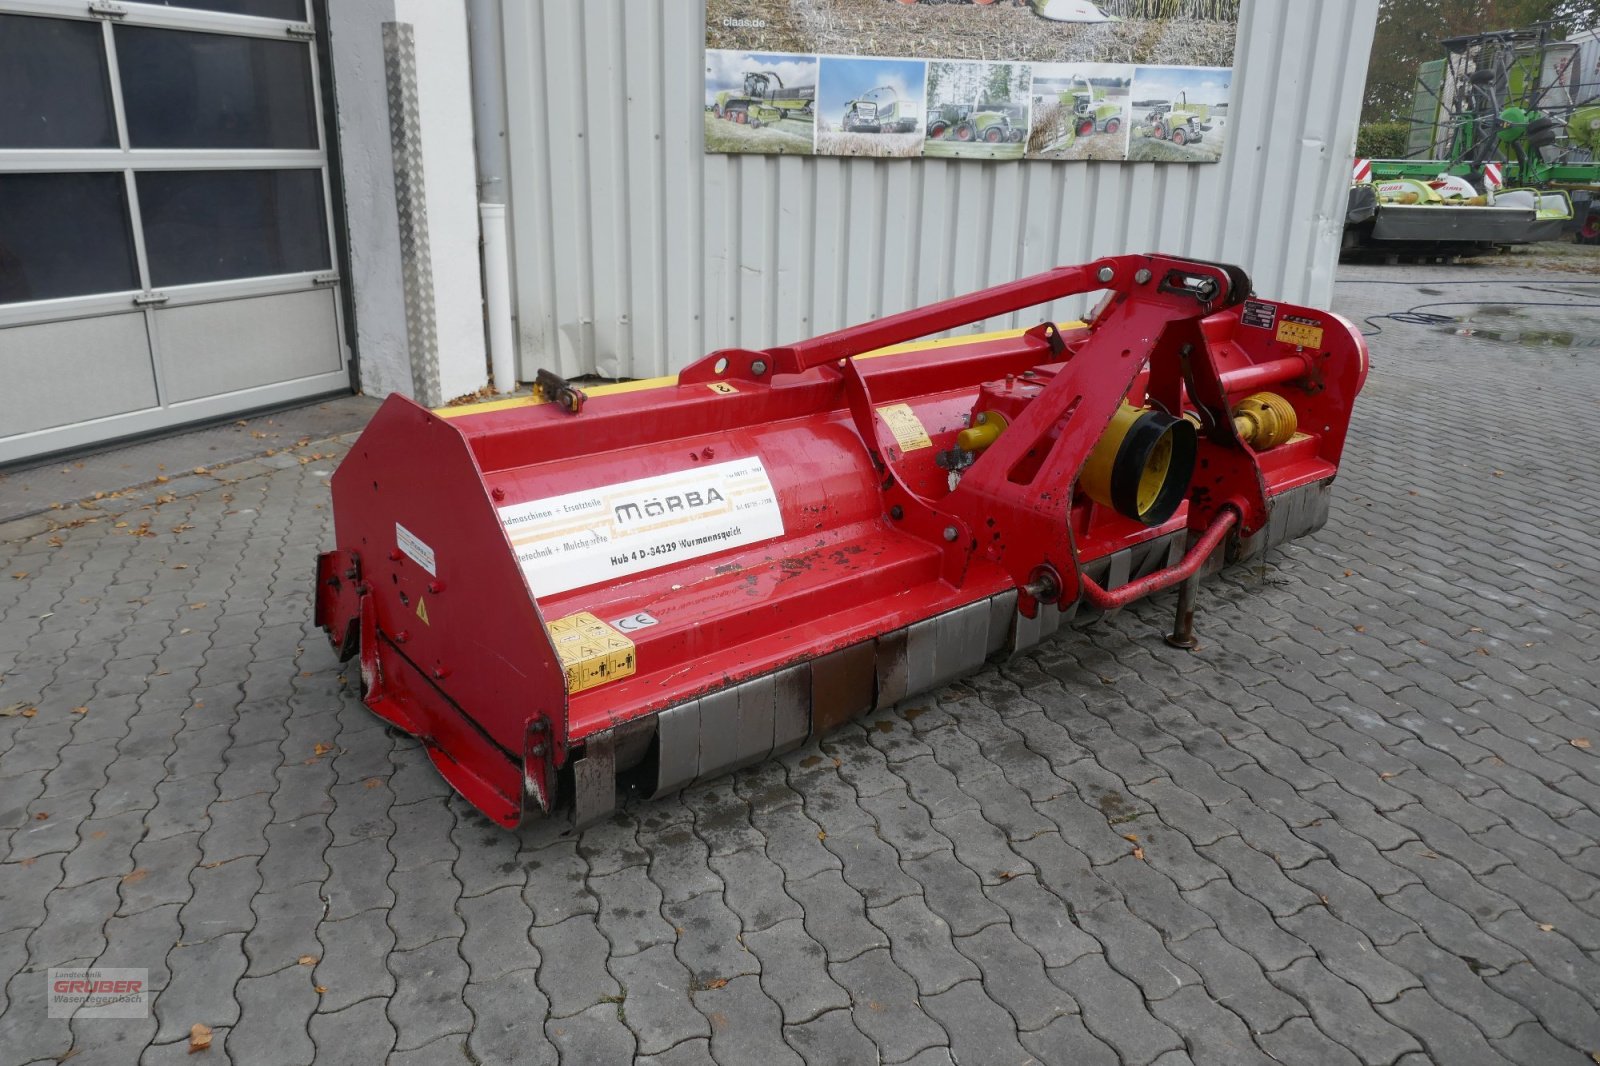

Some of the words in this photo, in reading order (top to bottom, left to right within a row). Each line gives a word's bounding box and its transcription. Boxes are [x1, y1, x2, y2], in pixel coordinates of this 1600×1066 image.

[723, 17, 766, 28] claas.de
[563, 499, 602, 513] Ersatzteile
[614, 488, 724, 524] MÖRBA
[610, 553, 629, 566] Hub
[631, 551, 638, 561] 4
[639, 542, 677, 559] D-34329
[619, 613, 654, 629] CE
